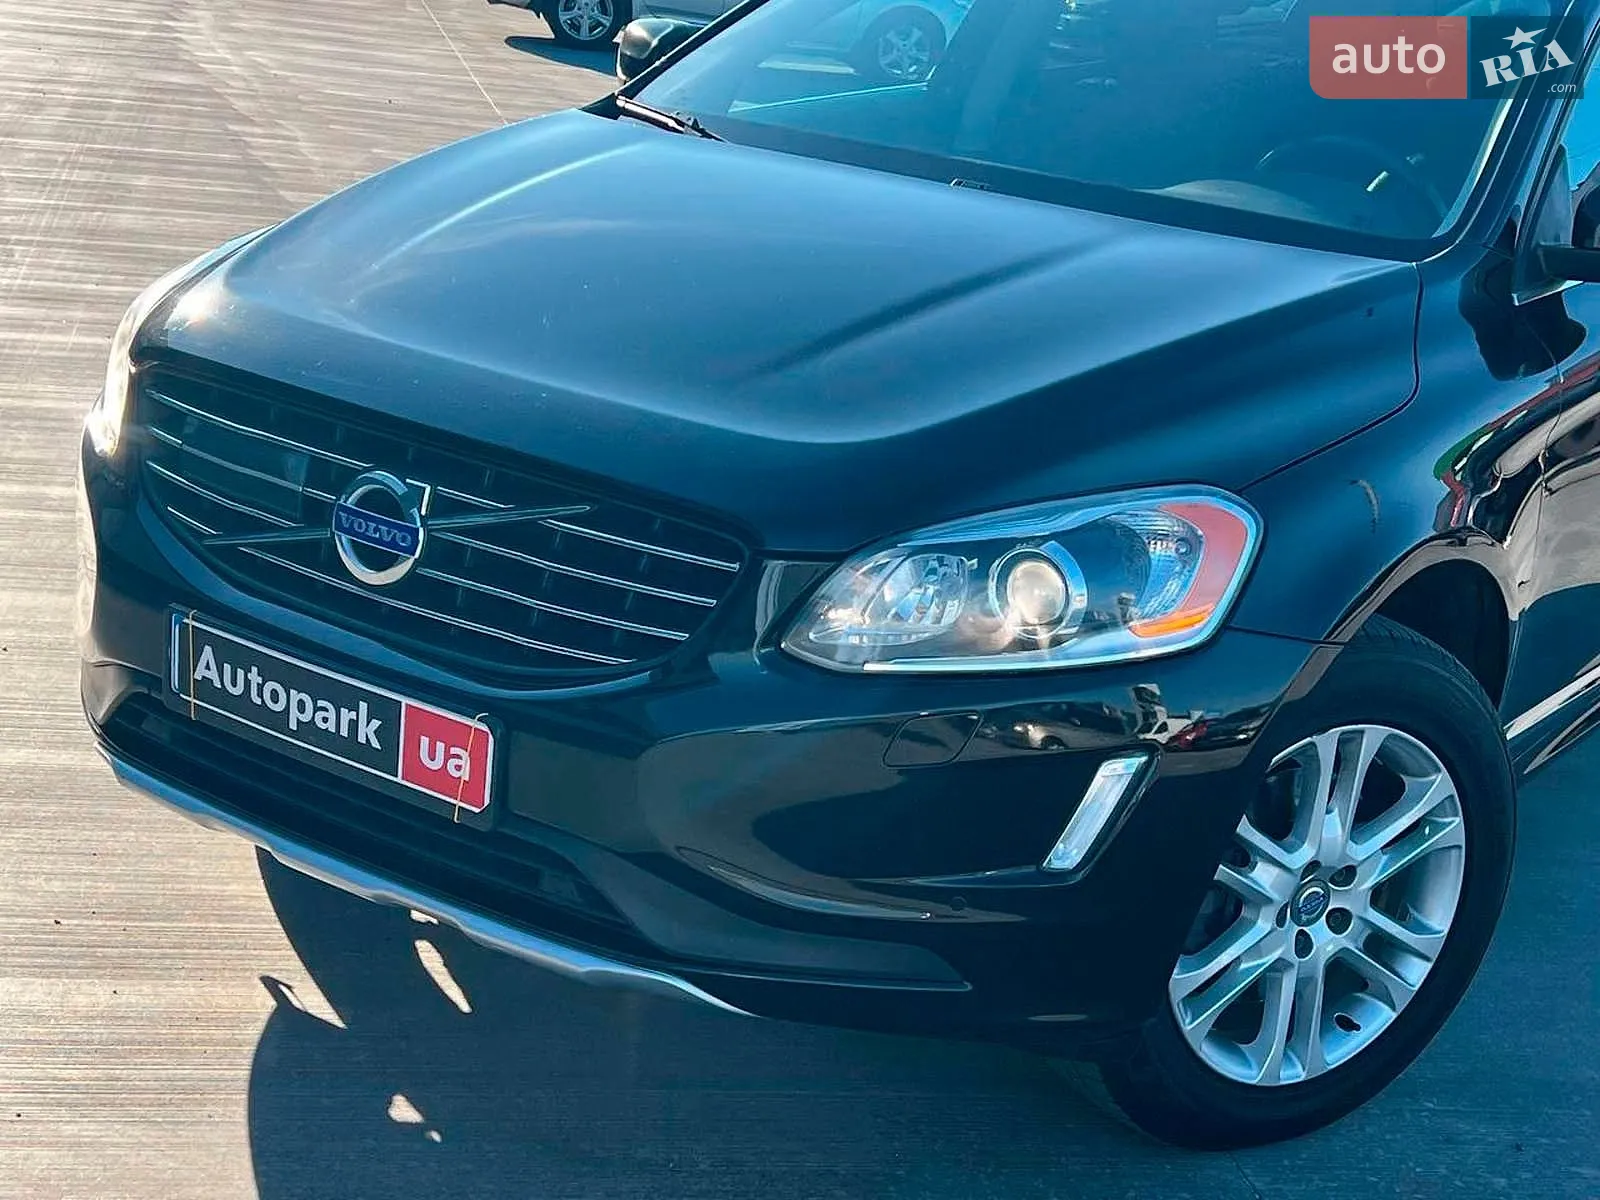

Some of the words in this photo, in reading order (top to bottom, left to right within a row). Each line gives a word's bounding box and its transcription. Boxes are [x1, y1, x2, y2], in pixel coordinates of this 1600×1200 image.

[338, 511, 412, 547] VOLVO
[193, 644, 382, 750] Autopark
[418, 735, 471, 782] ua
